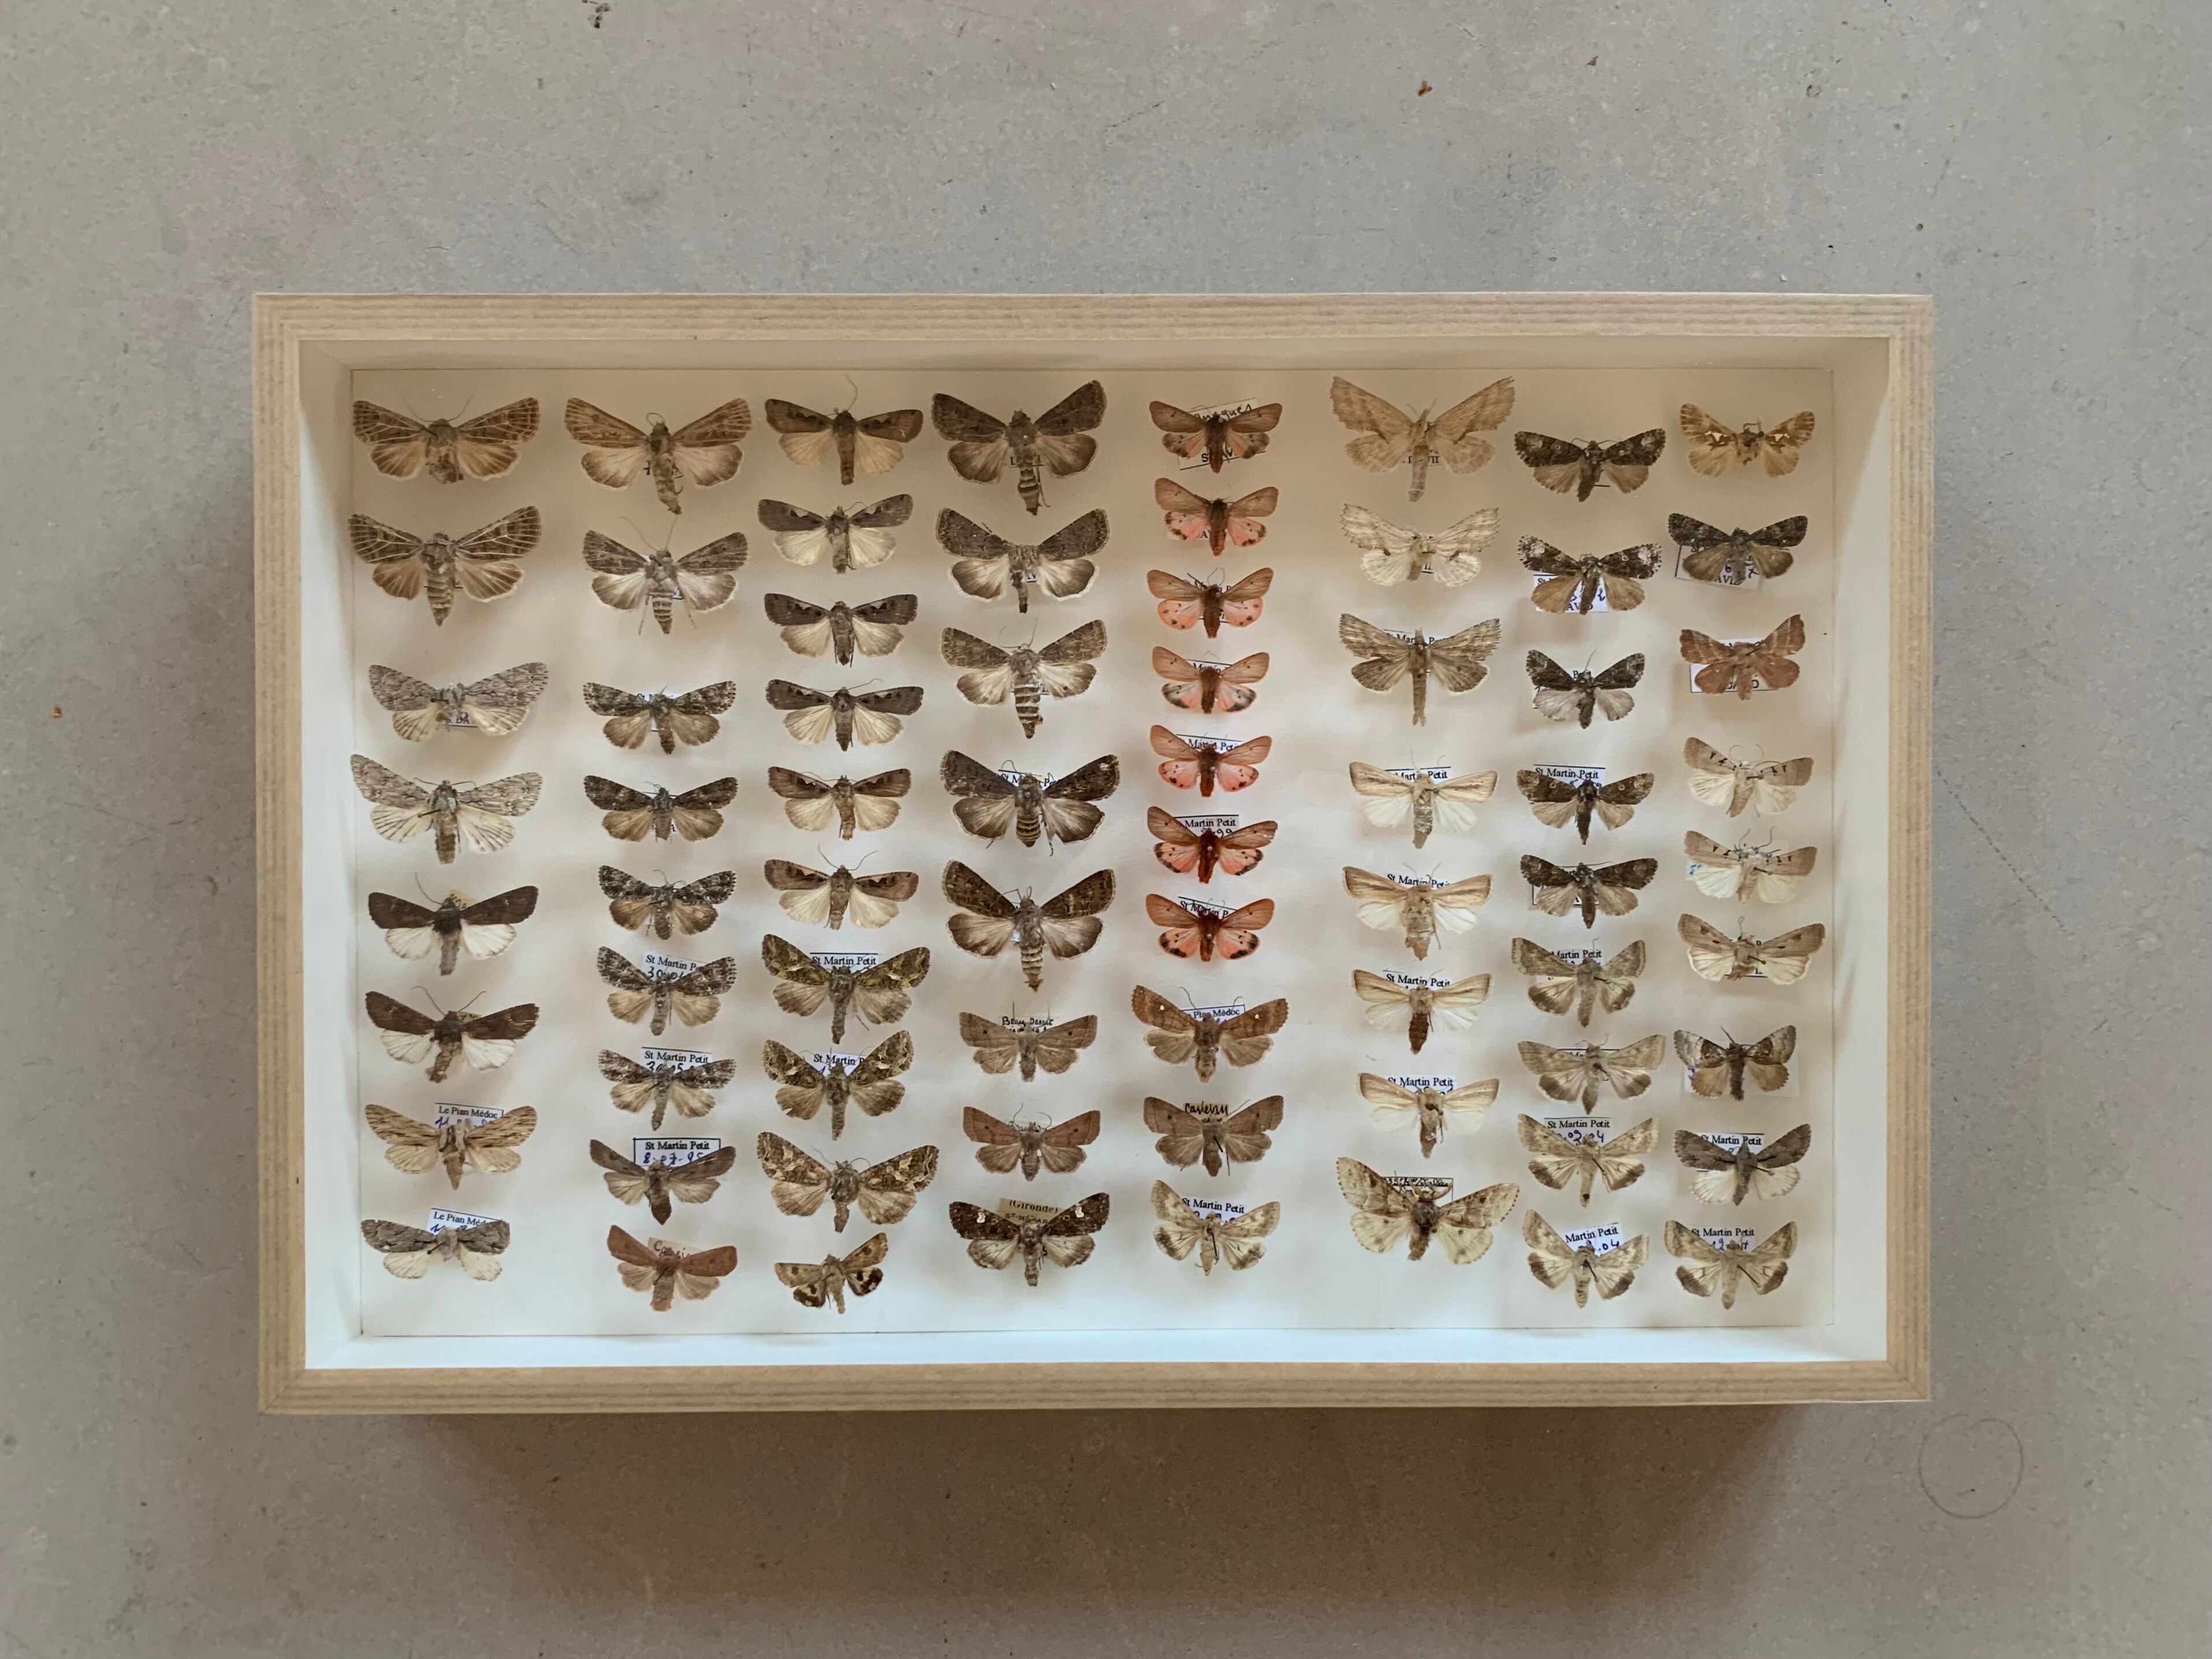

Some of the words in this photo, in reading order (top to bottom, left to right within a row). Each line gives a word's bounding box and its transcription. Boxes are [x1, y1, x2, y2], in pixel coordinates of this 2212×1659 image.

[1428, 770, 1448, 779] Petit
[1547, 768, 1577, 779] Martin
[1580, 770, 1599, 779] Petit
[1185, 819, 1213, 828] Martin
[1216, 818, 1236, 827] Petit
[645, 954, 655, 964] St
[658, 957, 687, 971] Martin
[812, 956, 821, 965] St
[824, 956, 854, 965] Martin
[856, 956, 876, 965] Petit
[1386, 973, 1394, 982] St
[1398, 975, 1428, 986] Martin
[644, 1050, 654, 1060] St
[657, 1052, 687, 1063] Martin
[689, 1054, 708, 1064] Petit
[813, 1054, 823, 1063] St
[826, 1054, 856, 1066] Martin
[1400, 1077, 1429, 1087] Martin
[1433, 1077, 1454, 1087] Petit
[439, 1106, 450, 1114] Le
[451, 1107, 469, 1117] Pian
[471, 1108, 498, 1119] Médoc
[1547, 1120, 1556, 1129] St
[1559, 1119, 1588, 1129] Martin
[1590, 1119, 1610, 1128] Petit
[645, 1141, 655, 1150] St
[657, 1141, 688, 1150] Martin
[690, 1141, 710, 1150] Petit
[1711, 1135, 1740, 1145] Martin
[1193, 1199, 1222, 1211] Martin
[1225, 1202, 1244, 1214] Petit
[433, 1211, 444, 1220] Le
[447, 1213, 465, 1224] Pian
[1565, 1229, 1595, 1244] Martin
[1598, 1225, 1620, 1239] Petit
[1703, 1228, 1732, 1236] Martin
[1735, 1227, 1755, 1236] Petit
